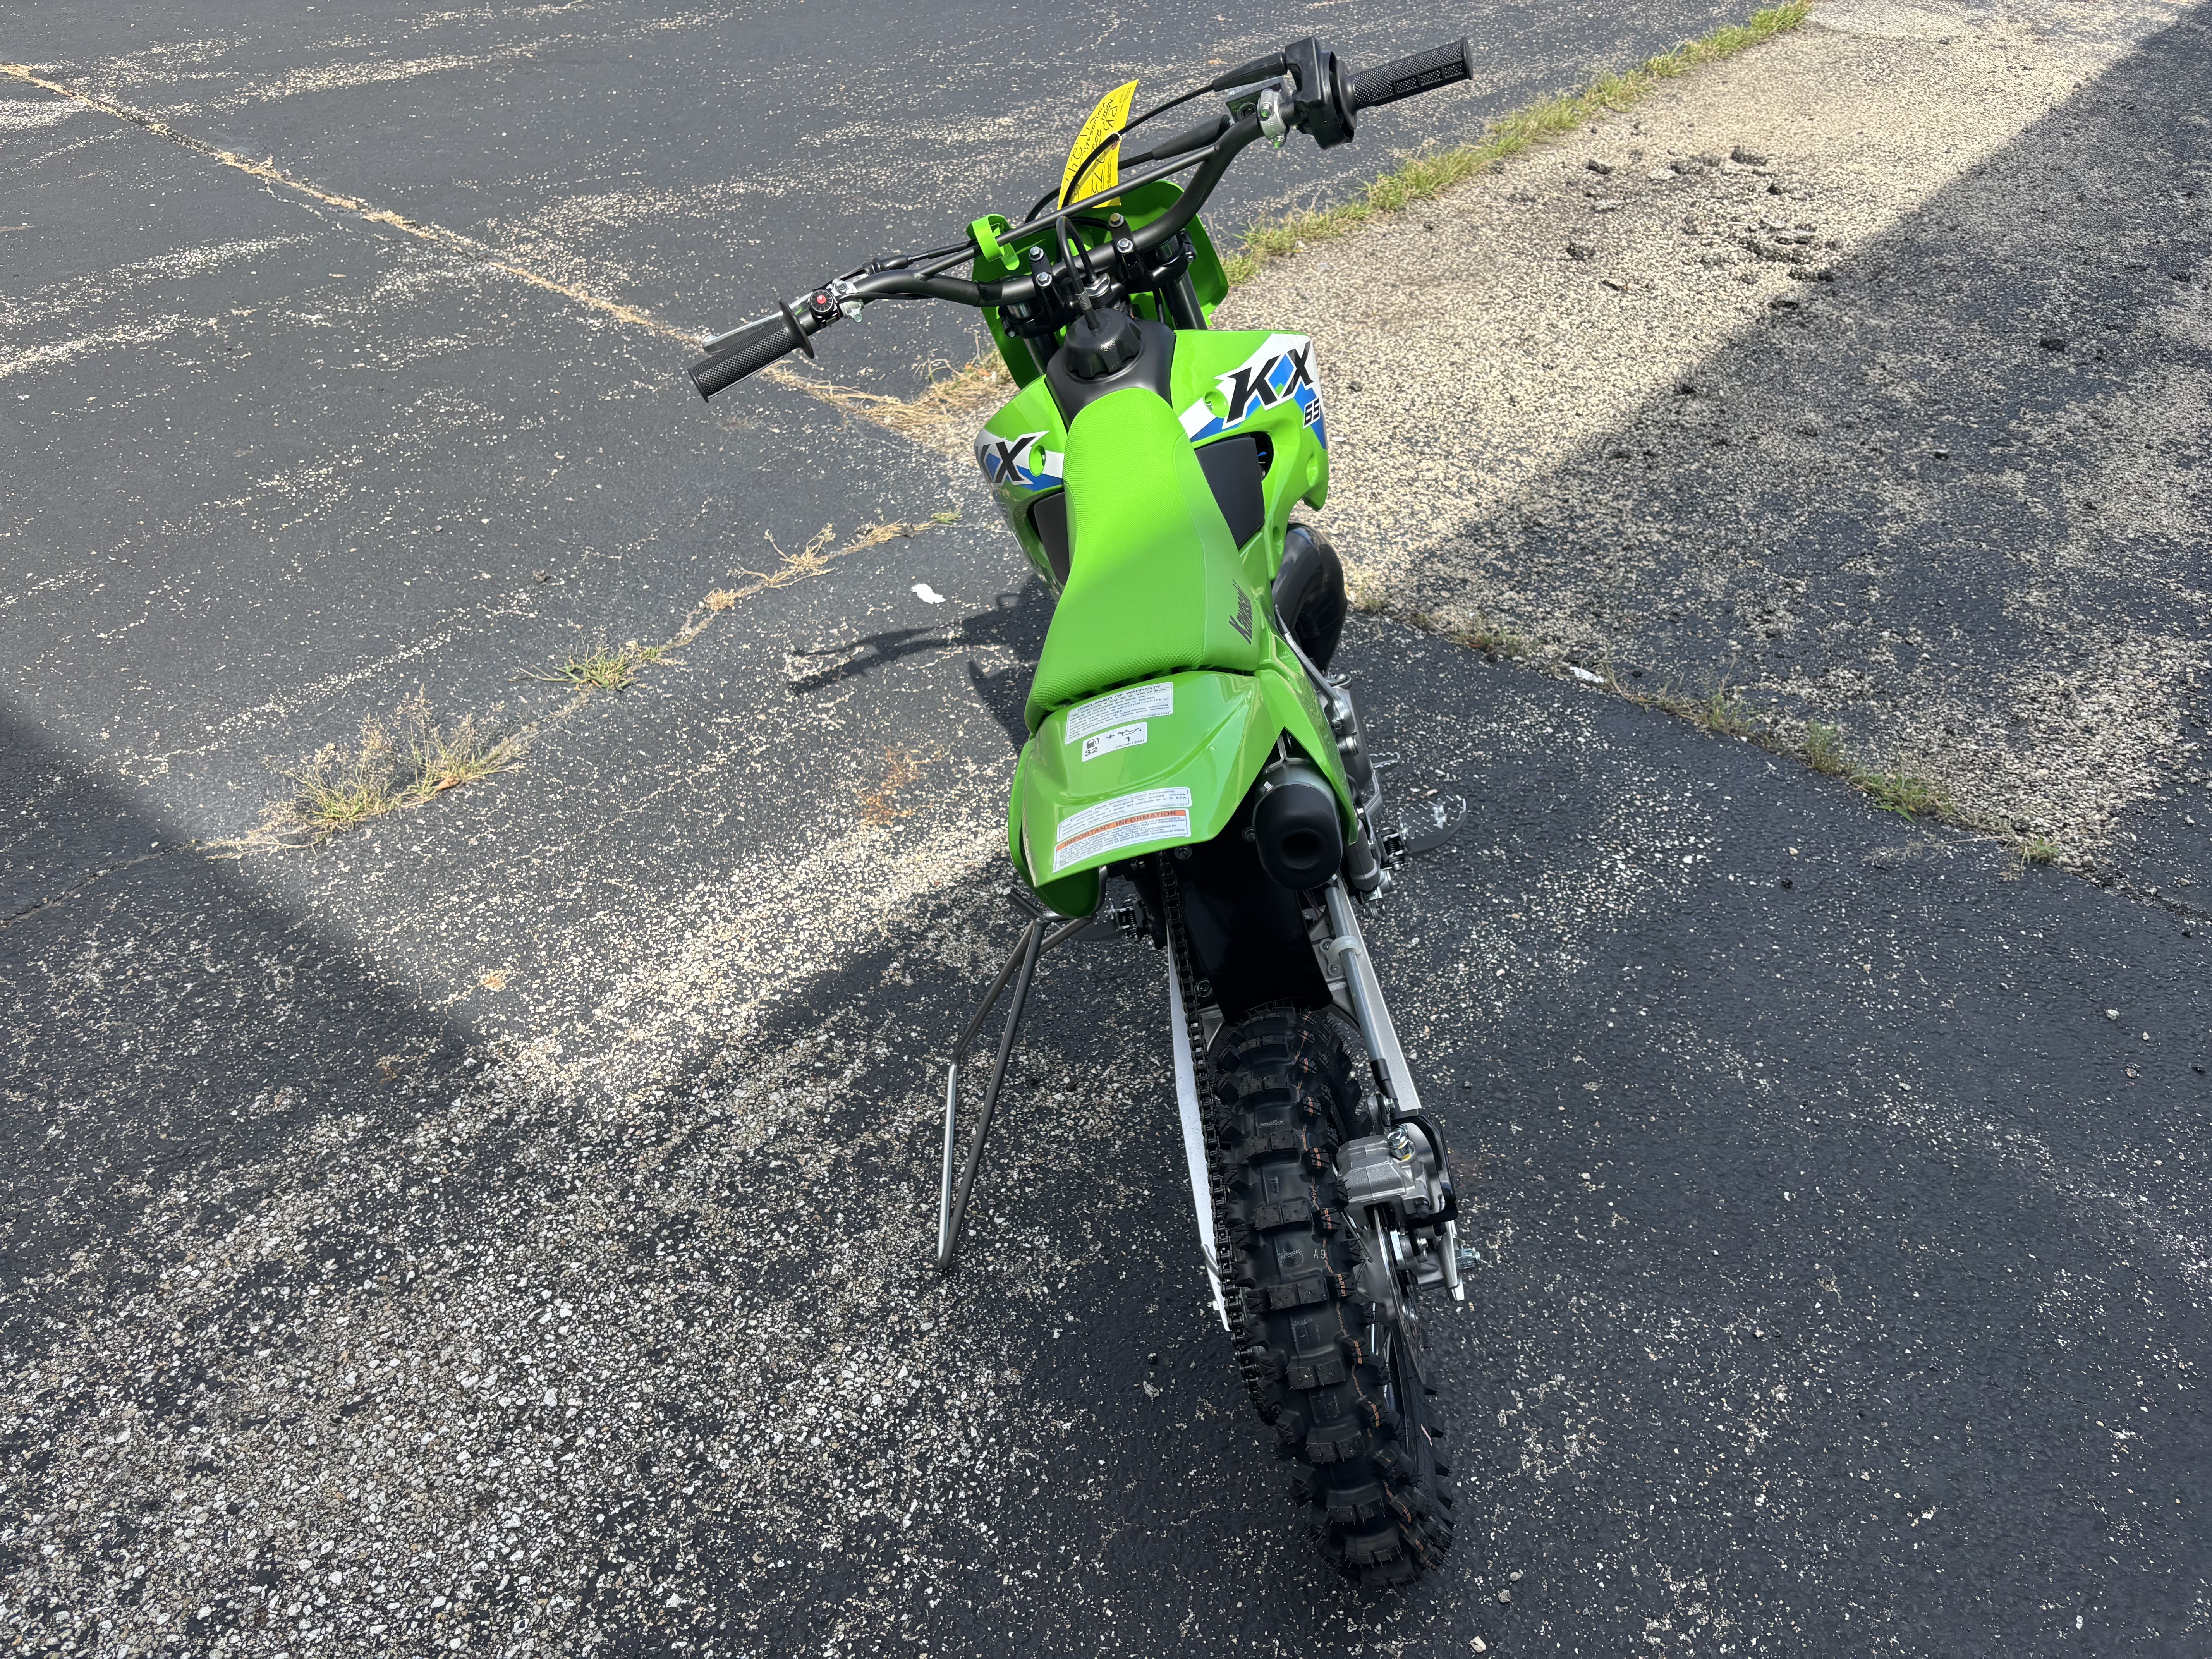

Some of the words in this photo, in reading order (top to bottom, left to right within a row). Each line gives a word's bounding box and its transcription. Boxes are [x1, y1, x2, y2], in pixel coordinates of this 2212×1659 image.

[1226, 340, 1314, 423] KX
[1304, 398, 1320, 426] 65
[1078, 697, 1112, 711] DISCLAIMER
[1126, 685, 1161, 694] WARRANTY
[1085, 747, 1098, 756] 32
[1065, 825, 1110, 847] IMPORTANT
[1116, 811, 1176, 826] INFORMATION
